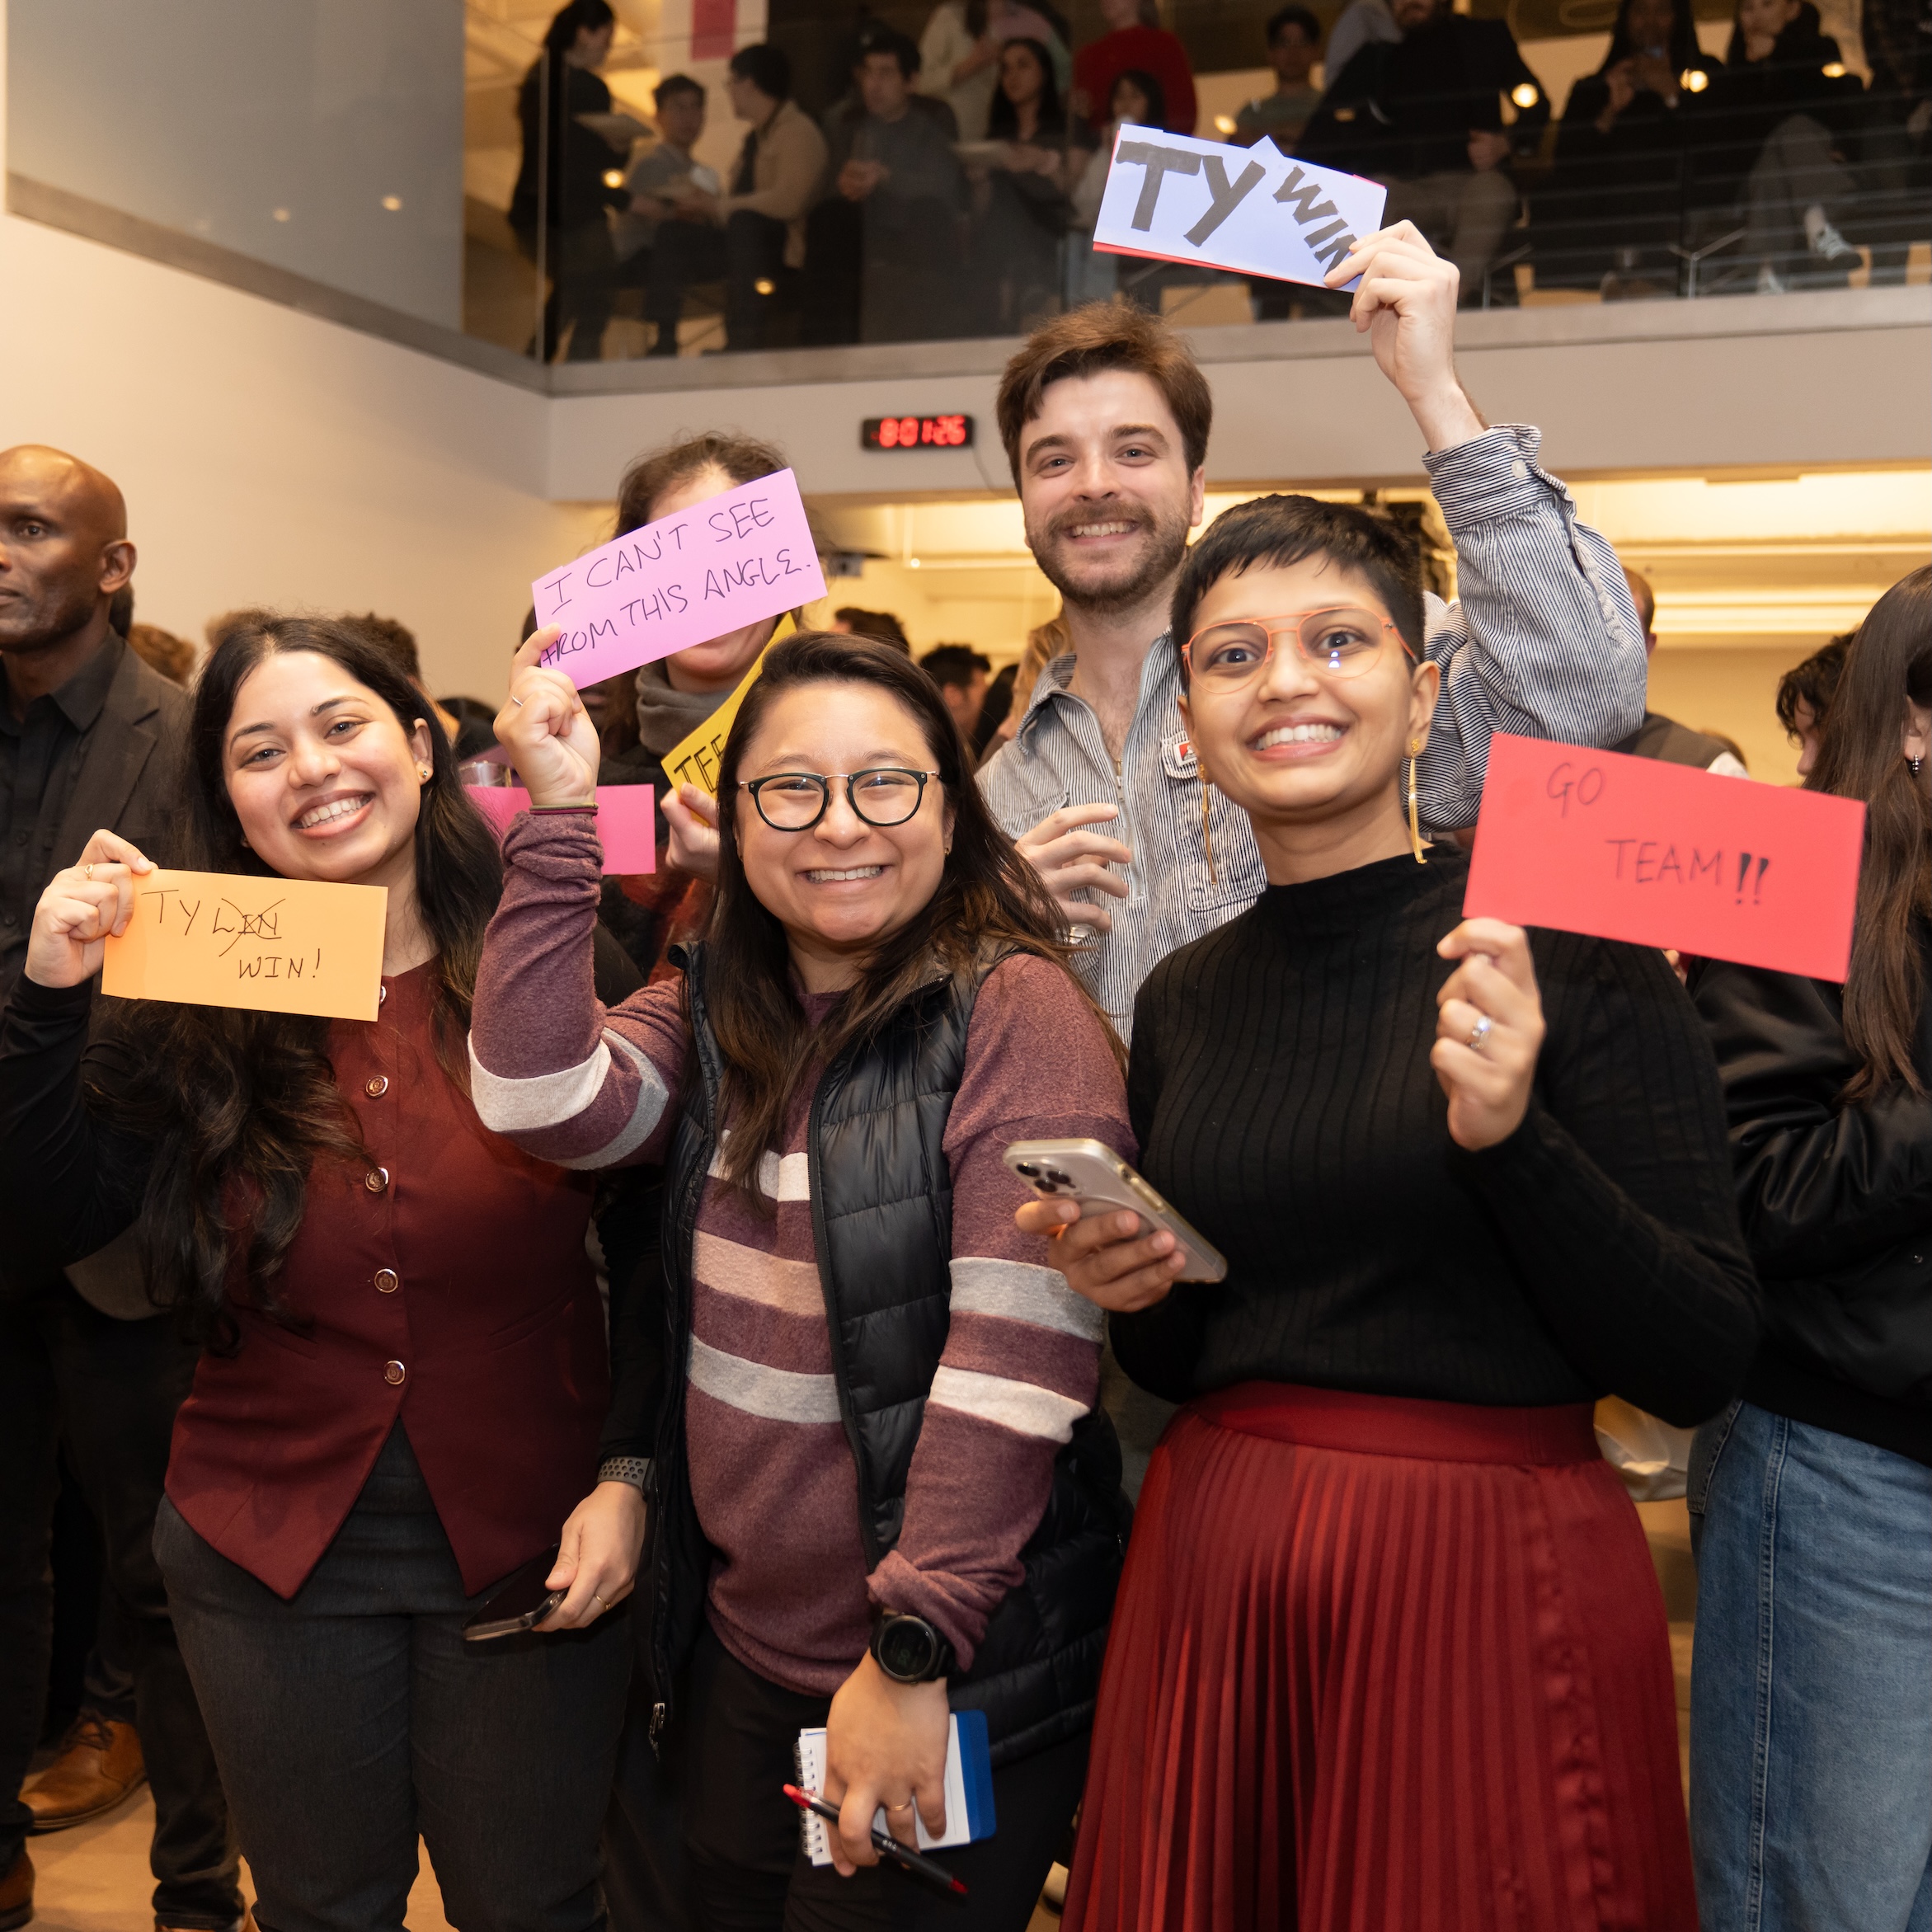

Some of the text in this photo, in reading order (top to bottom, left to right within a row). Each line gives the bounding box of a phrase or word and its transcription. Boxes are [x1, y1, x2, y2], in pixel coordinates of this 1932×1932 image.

[1115, 140, 1266, 247] TY
[544, 498, 774, 615] I CAN'T SEE
[620, 585, 688, 626] THIS
[704, 549, 811, 600] ANGLE.
[1546, 763, 1605, 818] GO
[239, 948, 321, 979] WIN!
